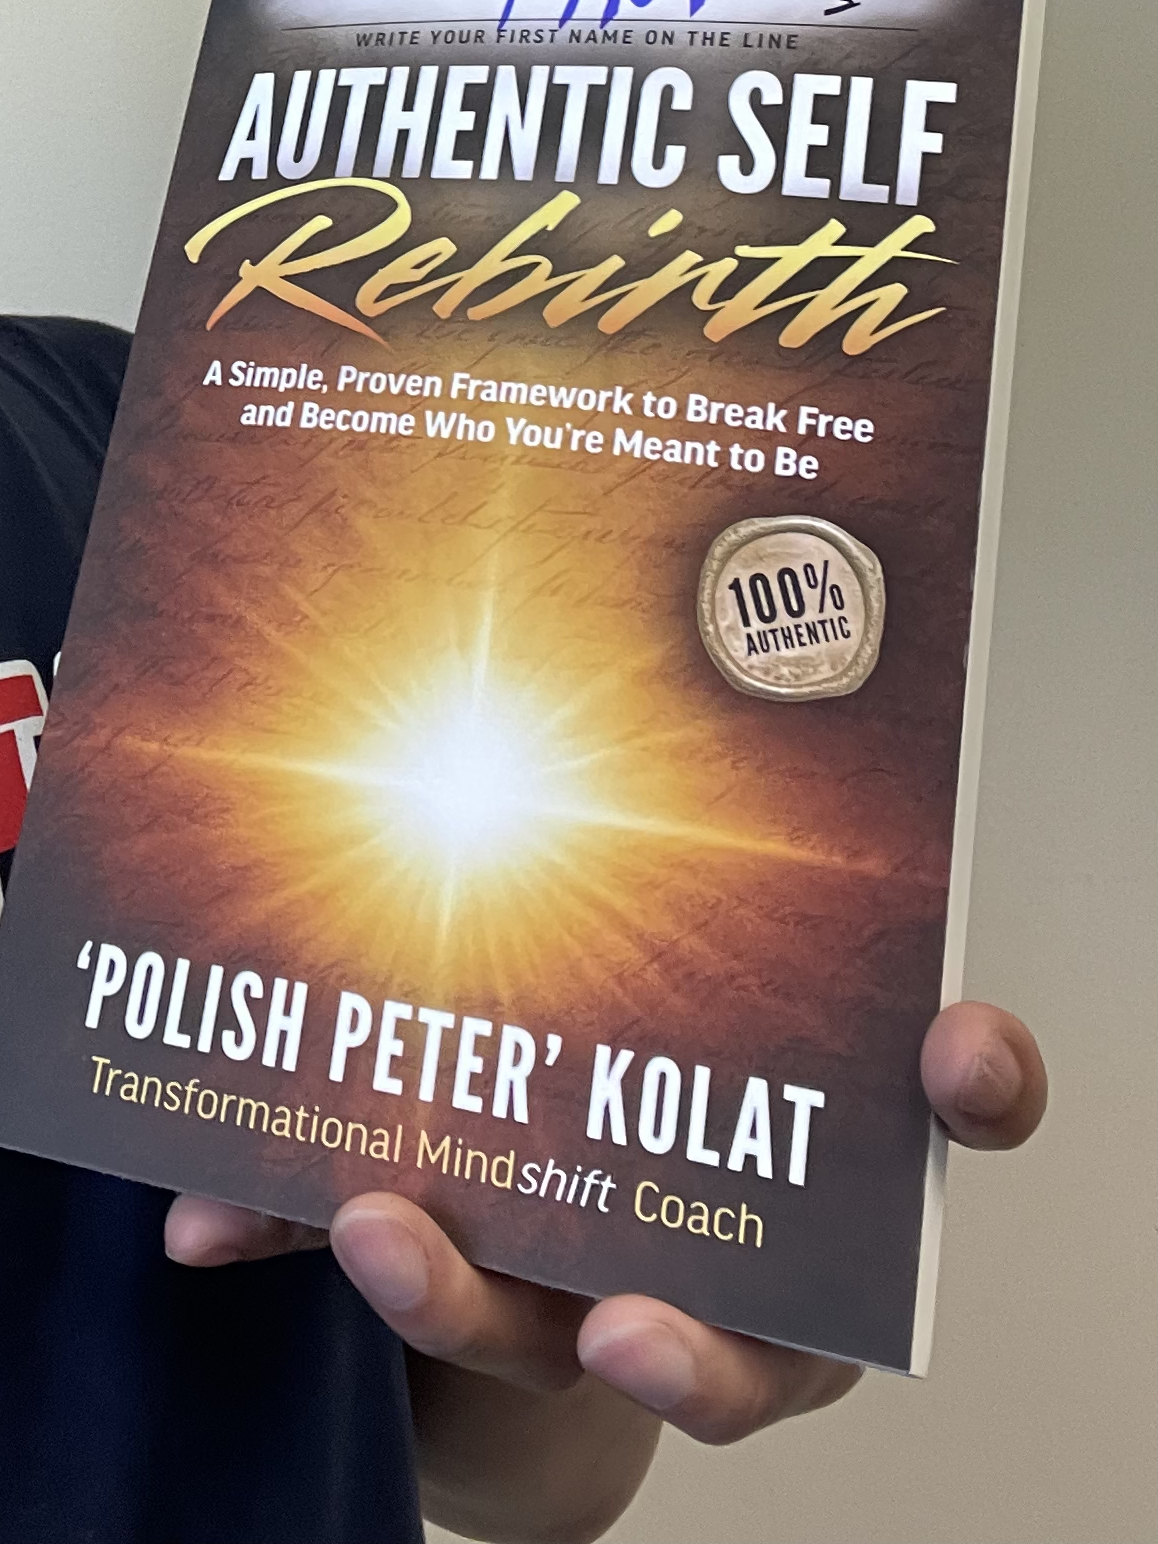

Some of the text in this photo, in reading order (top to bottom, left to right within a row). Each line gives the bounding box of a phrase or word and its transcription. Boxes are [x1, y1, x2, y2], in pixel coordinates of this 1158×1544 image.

[354, 29, 799, 51] WRITE YOUR FIRST NAME ON THE LINE
[218, 65, 959, 207] AUTHENTIC SELF
[184, 177, 959, 357] Rebirth
[203, 360, 876, 444] A Simple, Proven Framework to Break Free
[240, 400, 820, 481] and Become Who You're Meant to Be
[727, 559, 845, 631] 100%
[745, 615, 852, 658] AUTHENTIC
[76, 940, 826, 1187] 'POLISH PETER' KOLAT
[90, 1055, 765, 1249] Transformational Mindshift Coach
